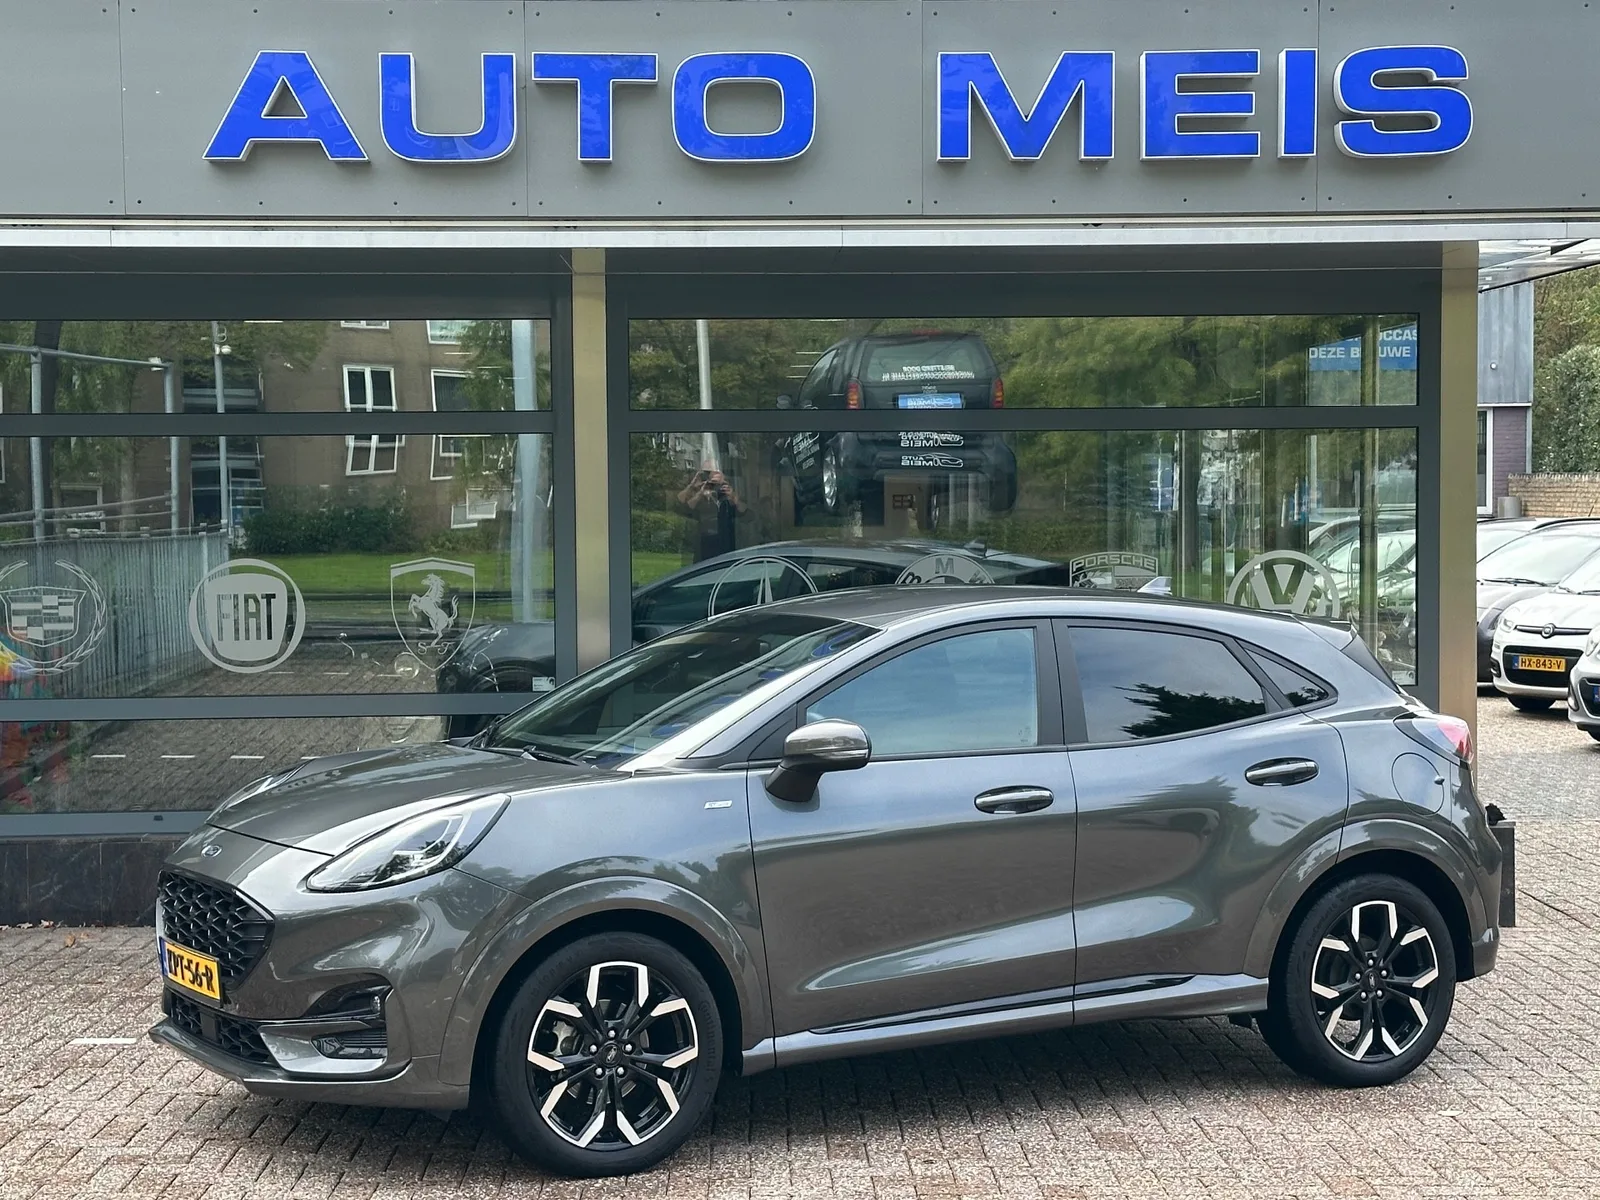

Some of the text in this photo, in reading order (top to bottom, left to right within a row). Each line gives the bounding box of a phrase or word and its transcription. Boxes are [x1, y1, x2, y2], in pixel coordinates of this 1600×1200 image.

[203, 44, 1474, 164] AUTO MEIS
[1309, 346, 1411, 358] DEZE BUWE
[1073, 554, 1155, 573] PORSCHE
[216, 593, 277, 642] FIAT
[1520, 657, 1562, 670] HX-843-V
